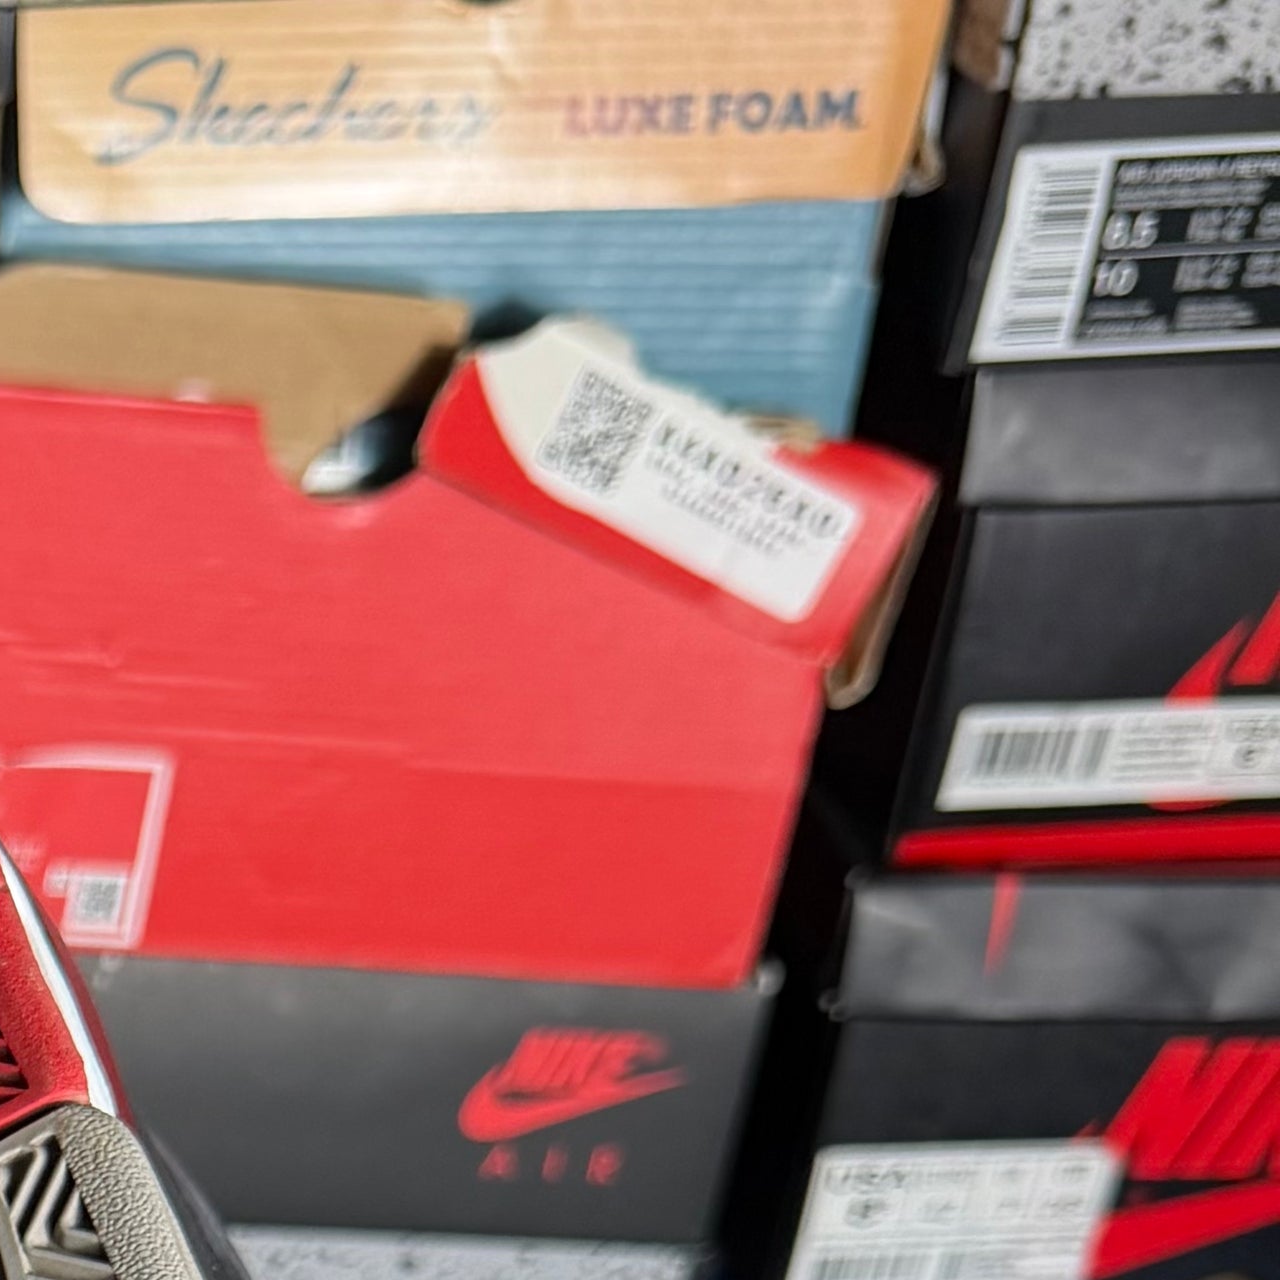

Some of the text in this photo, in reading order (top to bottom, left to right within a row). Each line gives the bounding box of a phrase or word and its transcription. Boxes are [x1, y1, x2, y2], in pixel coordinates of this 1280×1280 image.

[560, 89, 864, 137] LUXE FOAM
[498, 1026, 669, 1095] NIKE
[478, 1143, 625, 1188] AIR
